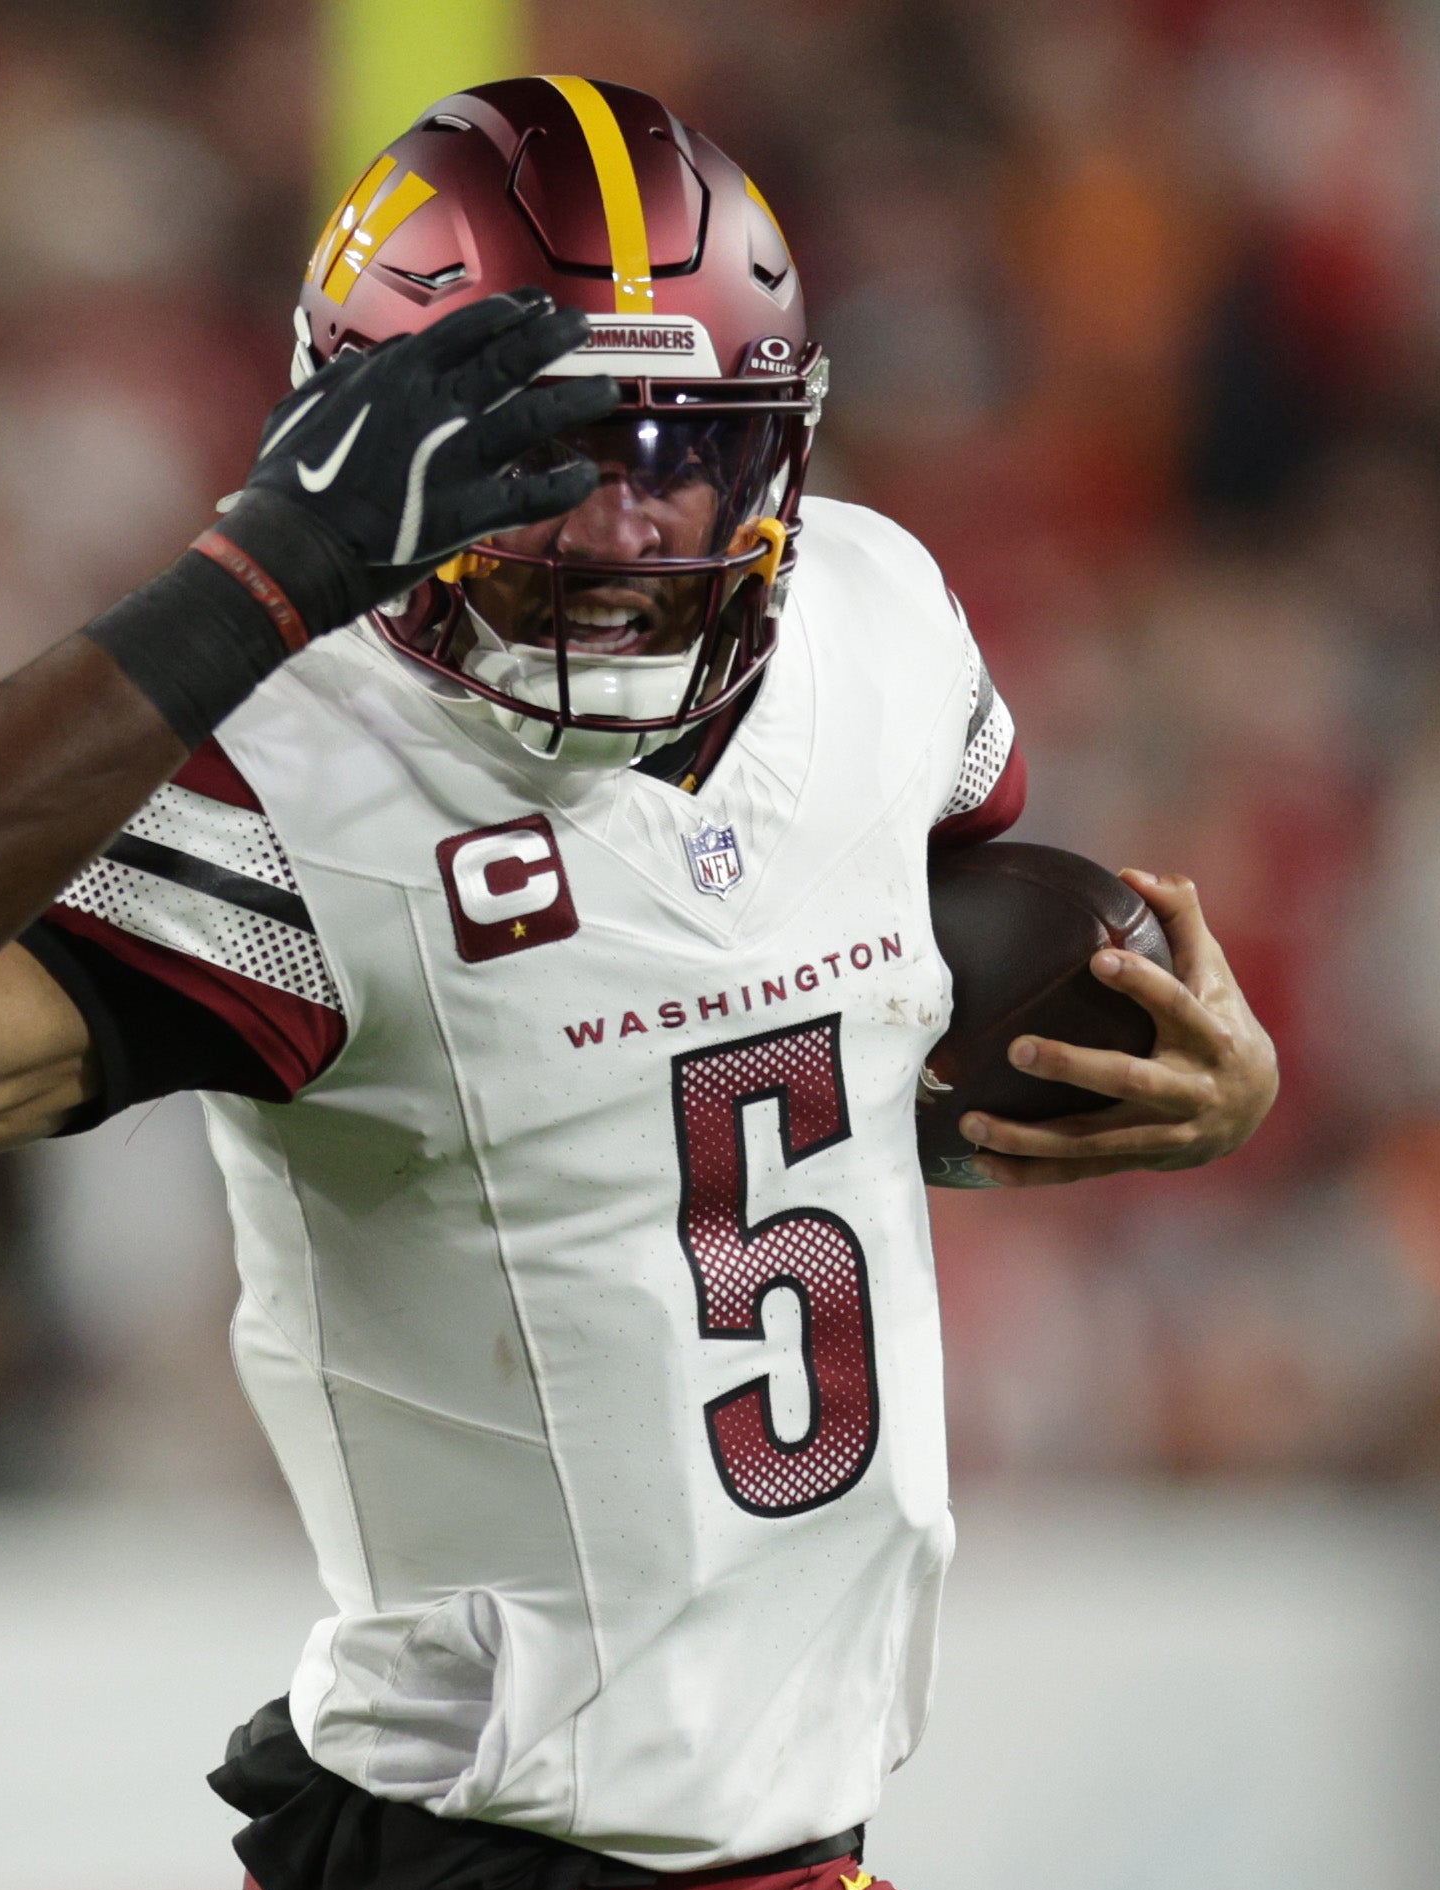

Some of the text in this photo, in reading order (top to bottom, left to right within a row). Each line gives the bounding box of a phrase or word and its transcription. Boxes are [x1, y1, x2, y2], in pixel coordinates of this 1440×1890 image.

[586, 329, 695, 349] OMMANDERS
[751, 357, 795, 375] OAKLEY
[451, 829, 559, 925] C
[699, 852, 738, 884] NFL
[563, 932, 904, 1049] WASHINGTON
[672, 1012, 880, 1518] 5
